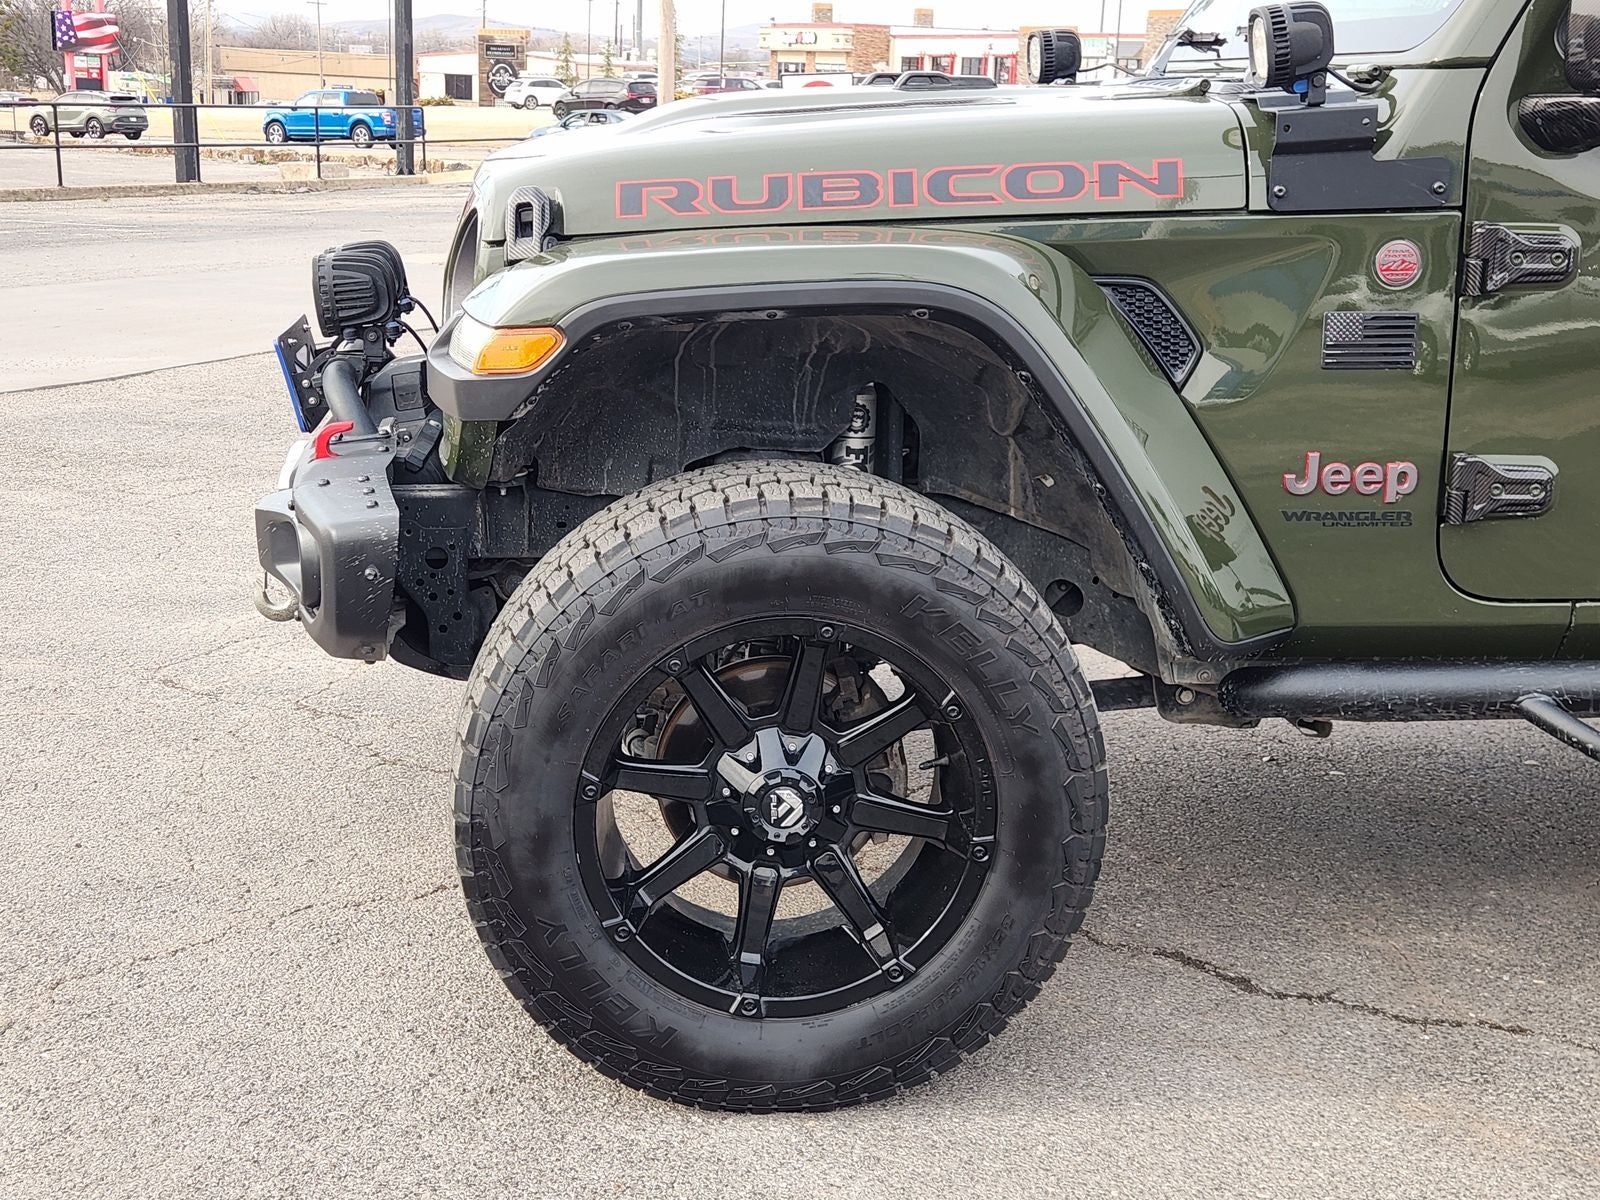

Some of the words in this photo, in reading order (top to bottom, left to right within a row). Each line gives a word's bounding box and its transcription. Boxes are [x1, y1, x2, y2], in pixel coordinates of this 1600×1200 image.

[616, 158, 1183, 218] RUBICON
[1282, 451, 1419, 504] Jeep
[1280, 510, 1413, 522] WRANGLER
[557, 621, 649, 722] SAFARI
[899, 593, 1042, 737] KELLY
[770, 794, 778, 824] FUEL
[534, 915, 681, 1049] KELLY
